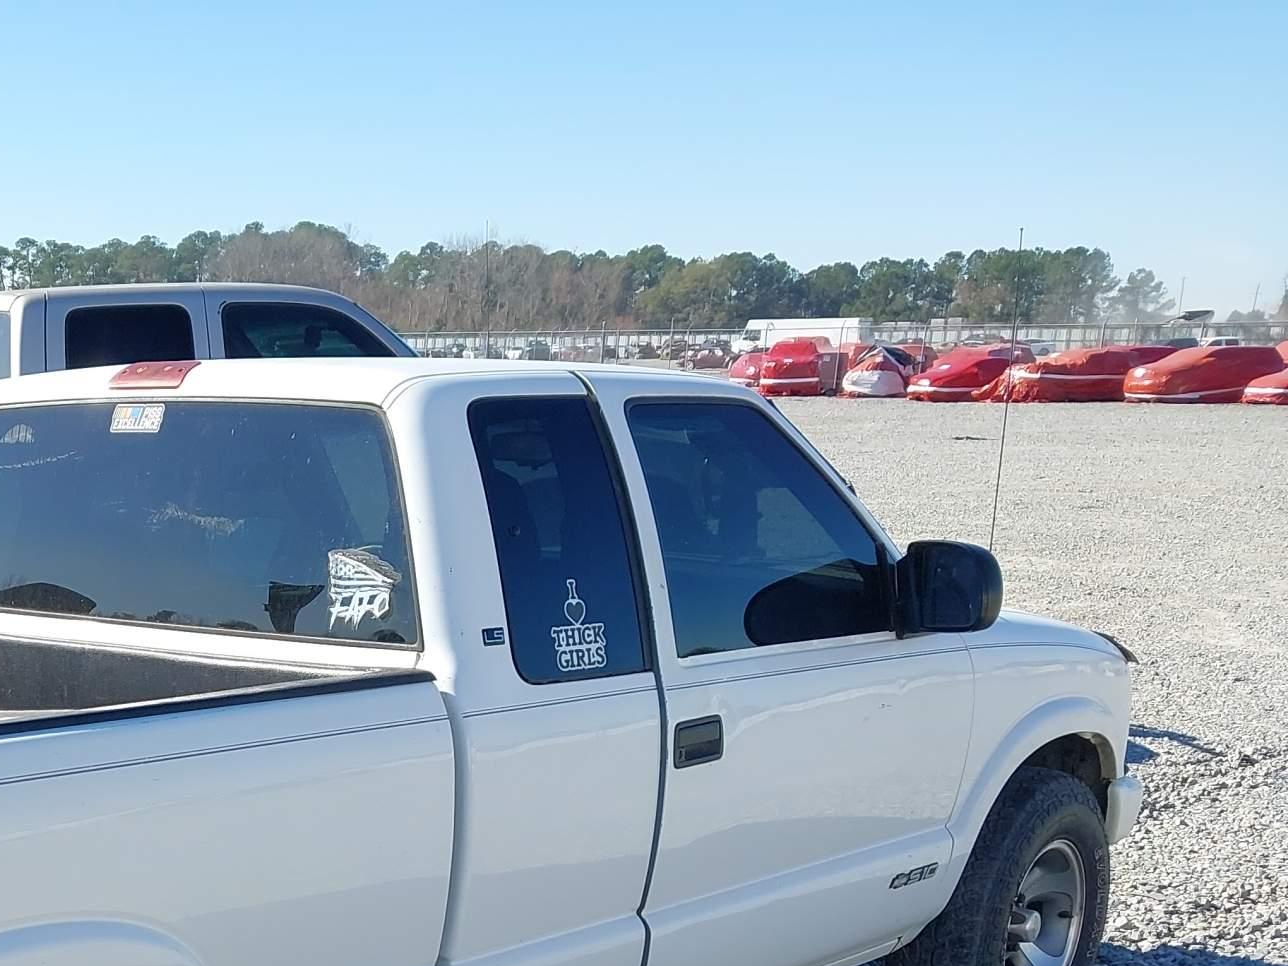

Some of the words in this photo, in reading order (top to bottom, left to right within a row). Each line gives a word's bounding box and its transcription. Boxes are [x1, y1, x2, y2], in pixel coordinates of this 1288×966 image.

[113, 418, 160, 429] EXCELLENCE
[567, 580, 578, 600] I
[483, 628, 505, 645] LS
[552, 624, 605, 649] THICK
[558, 646, 606, 670] GIRLS
